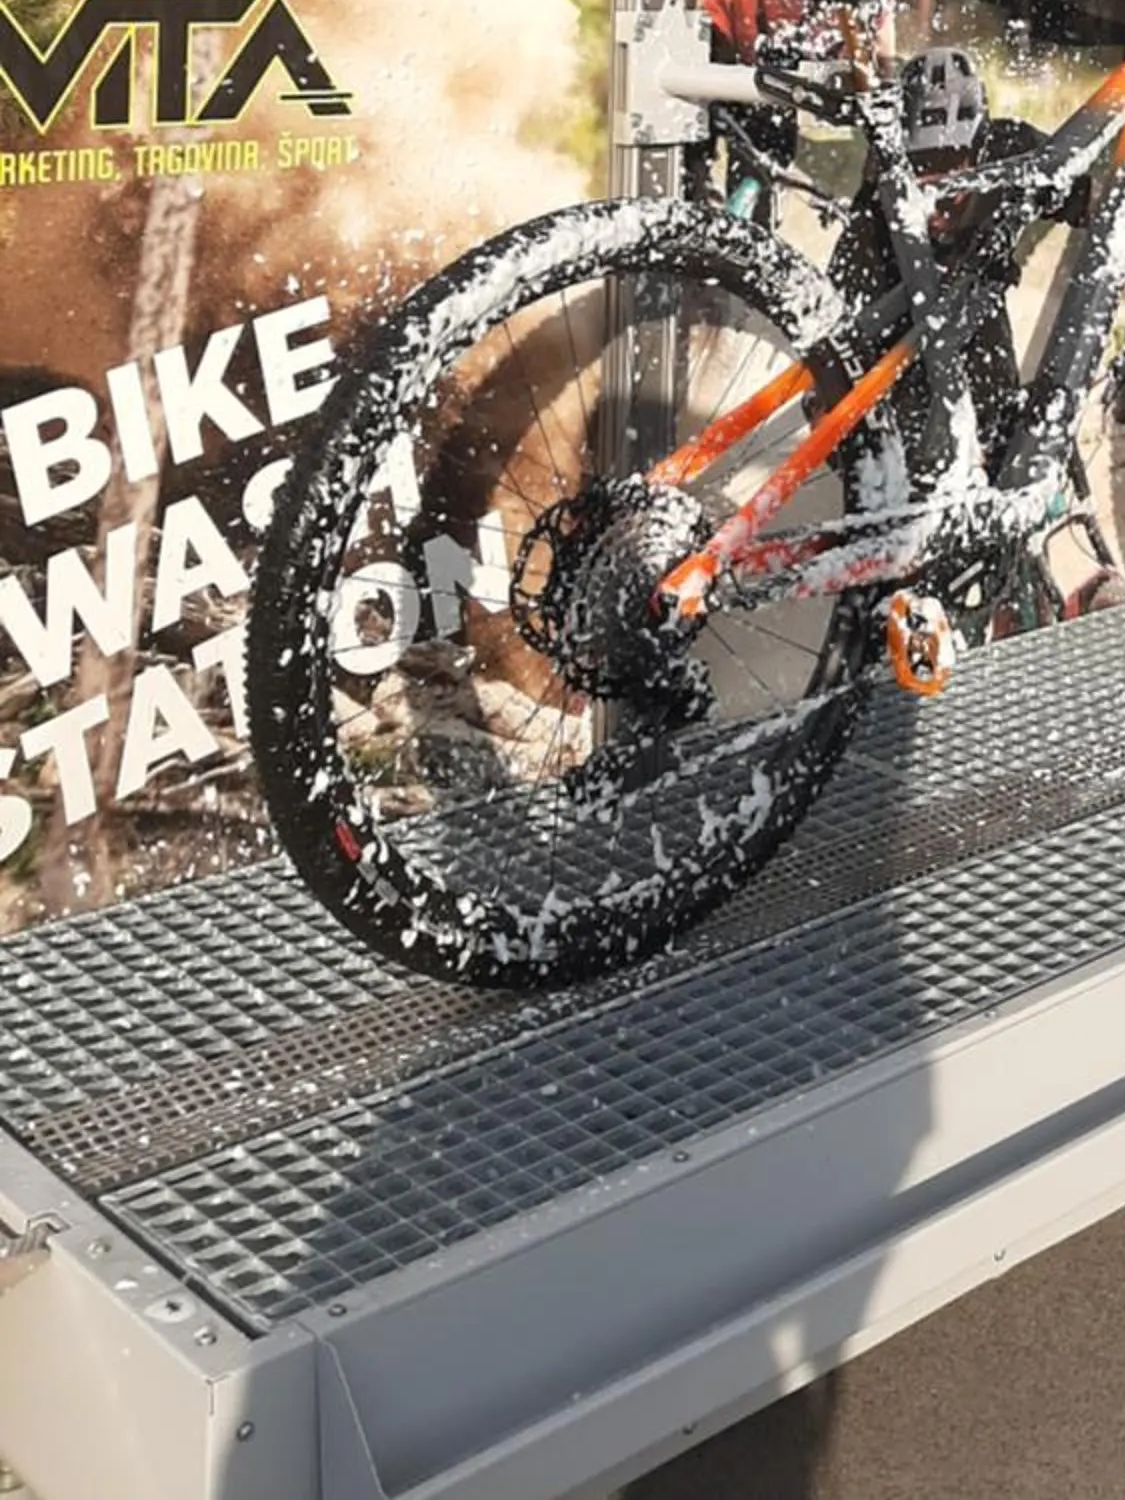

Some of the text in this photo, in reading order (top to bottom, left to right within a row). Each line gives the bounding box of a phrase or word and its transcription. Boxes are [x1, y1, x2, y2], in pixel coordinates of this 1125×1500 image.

[278, 132, 357, 172] ŠPORT
[2, 296, 340, 526] BIKE
[0, 510, 511, 865] TATON
